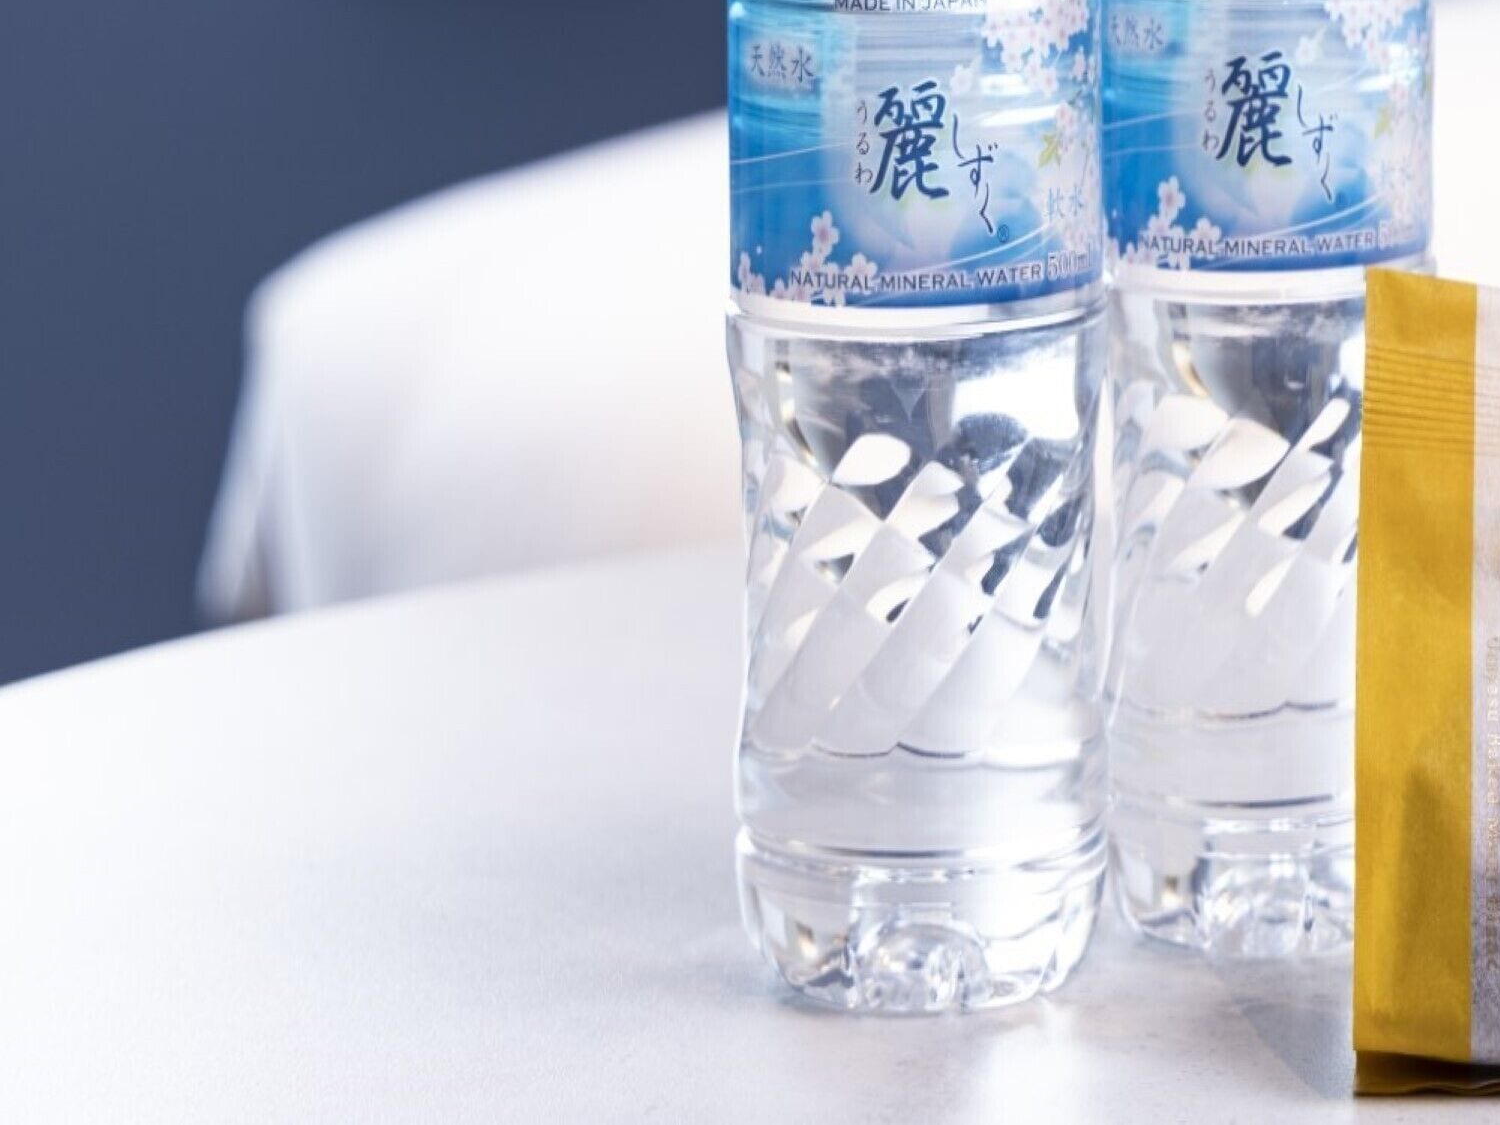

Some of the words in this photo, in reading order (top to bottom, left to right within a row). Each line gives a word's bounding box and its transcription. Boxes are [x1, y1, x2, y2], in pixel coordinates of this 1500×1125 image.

[749, 42, 815, 82] 天然水
[855, 99, 874, 185] うるわ
[868, 79, 950, 201] 麗
[1202, 68, 1220, 152] うるわ
[1215, 50, 1293, 167] 麗
[1296, 83, 1338, 202] しずく
[951, 112, 999, 236] しずく
[789, 270, 873, 292] NATURAL
[879, 268, 967, 292] MINERAL
[976, 264, 1043, 287] WATER
[1139, 234, 1219, 256] NATURAL
[1224, 236, 1309, 257] MINERAL
[1316, 231, 1374, 252] WATER
